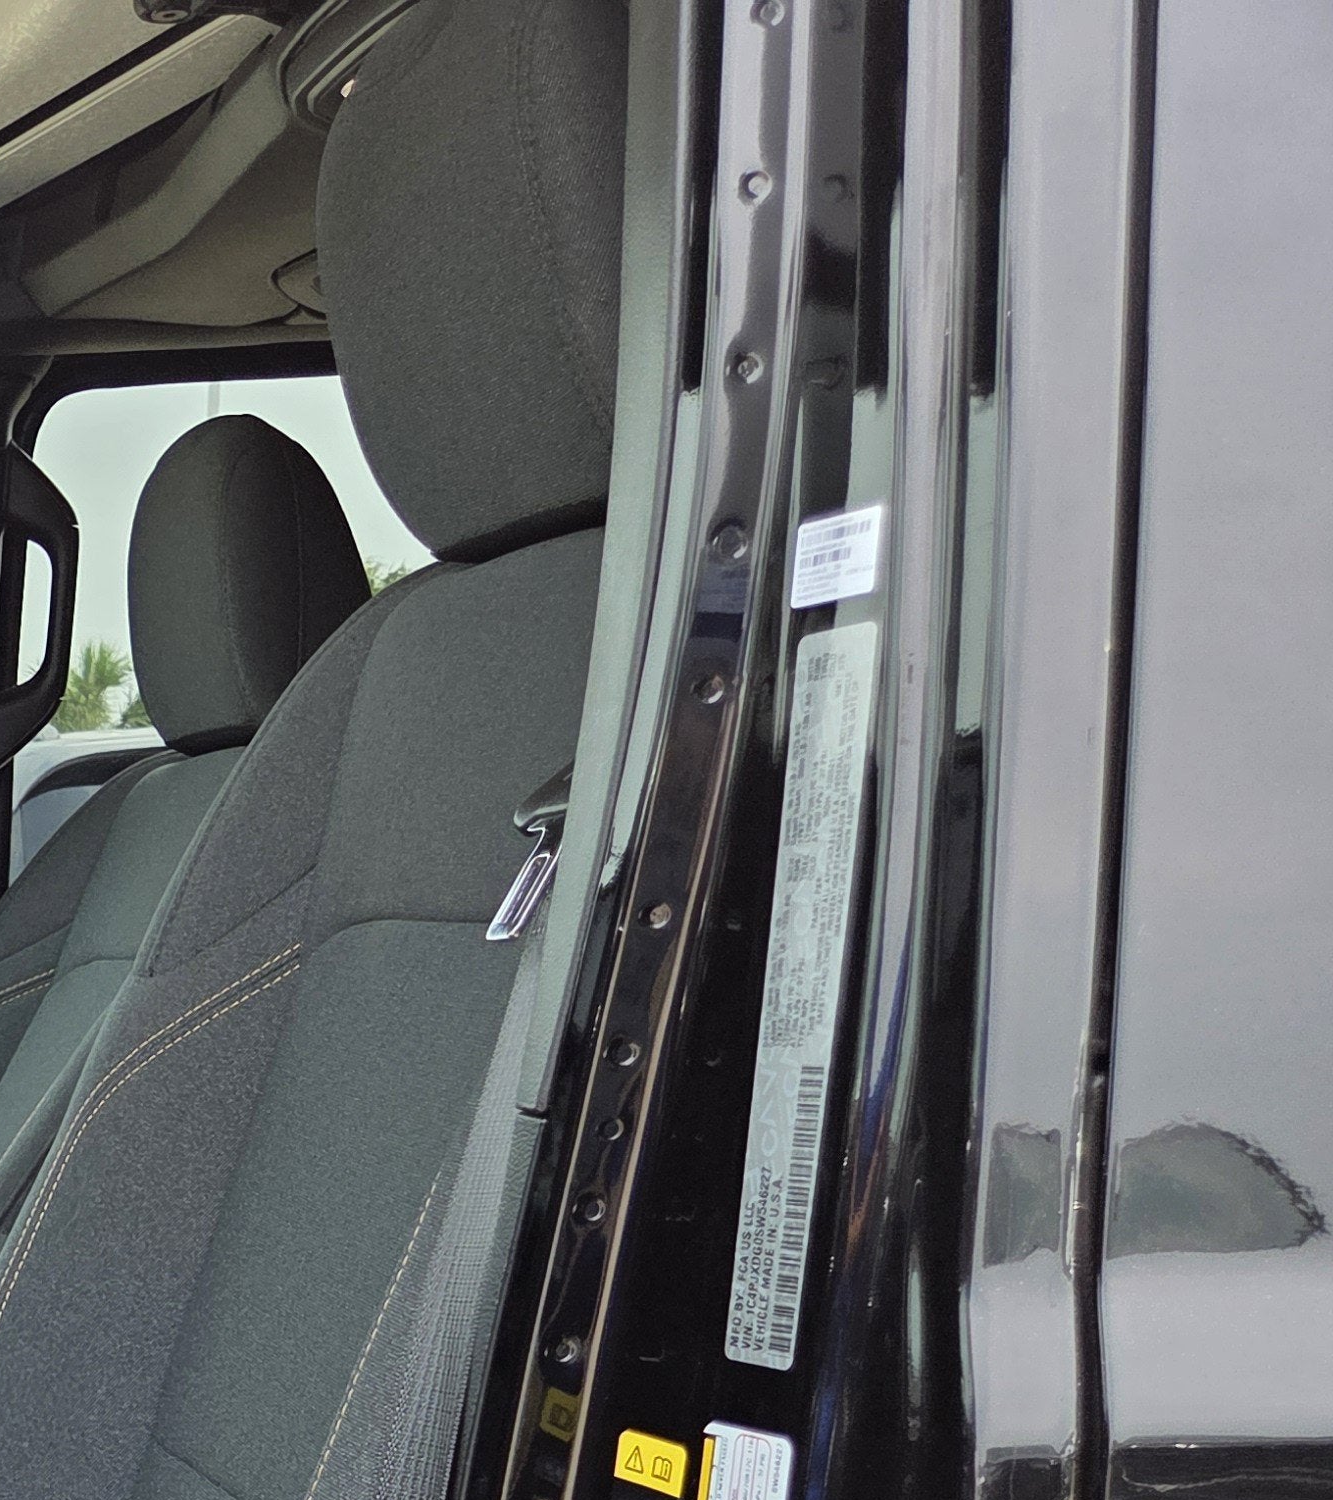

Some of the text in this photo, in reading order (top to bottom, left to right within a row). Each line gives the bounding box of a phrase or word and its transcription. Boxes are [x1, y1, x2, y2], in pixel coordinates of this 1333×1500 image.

[744, 1202, 755, 1226] LLC
[741, 1232, 751, 1249] US
[737, 1256, 749, 1281] FCA
[753, 1295, 769, 1351] VEHICLE
[761, 1249, 775, 1289] MADE
[730, 1317, 741, 1346] MFD
[742, 1322, 753, 1348] VIN:
